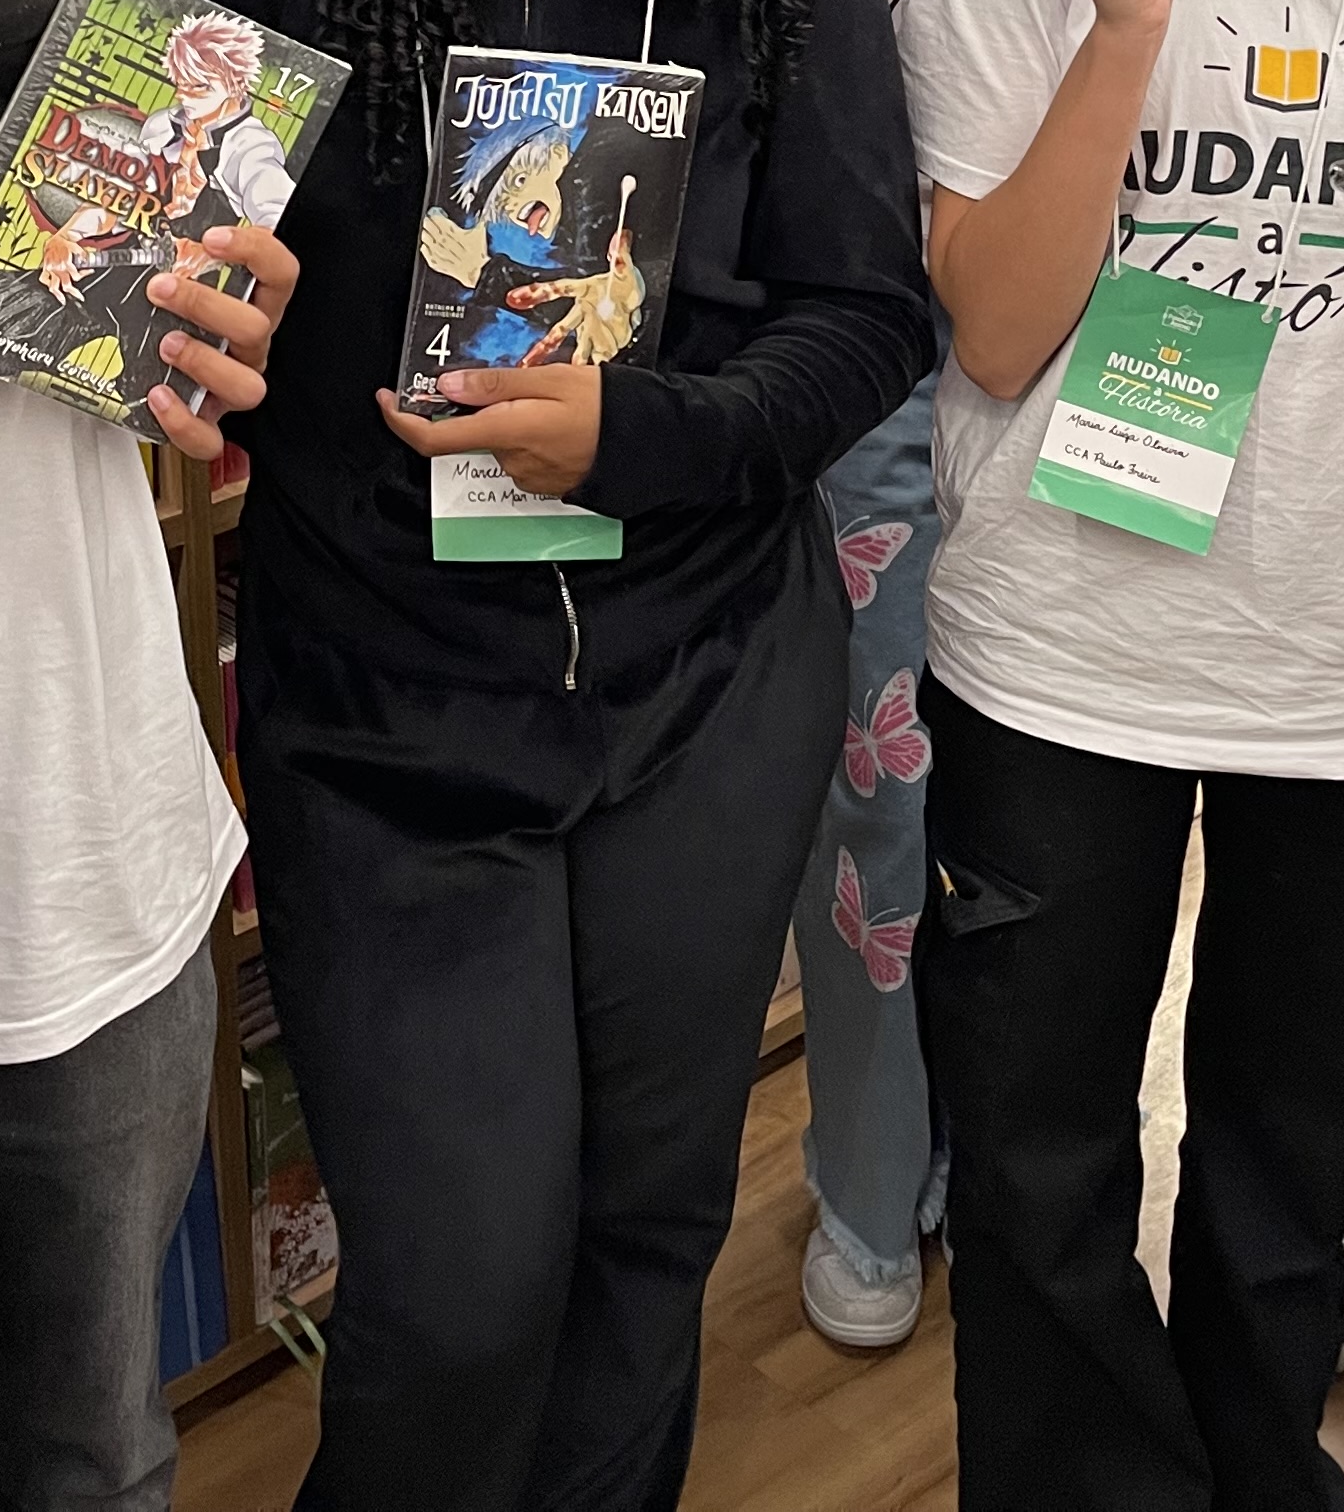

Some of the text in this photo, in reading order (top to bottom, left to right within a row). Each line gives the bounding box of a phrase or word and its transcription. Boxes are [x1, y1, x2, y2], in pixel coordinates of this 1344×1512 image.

[268, 66, 315, 103] 17
[450, 69, 695, 140] JUJUTSU KAISEN
[35, 105, 183, 204] DEMON
[14, 149, 163, 238] SLAYER
[1258, 222, 1283, 255] a
[425, 323, 451, 367] 4
[57, 359, 117, 394] Gotouge
[413, 371, 437, 395] Geg
[1107, 351, 1220, 400] MUDANDO
[1153, 386, 1163, 397] a
[1098, 373, 1209, 430] História
[1066, 413, 1106, 432] Maria
[452, 460, 506, 481] Marcel
[1065, 443, 1089, 460] CCA
[1094, 452, 1125, 470] Paulo
[467, 491, 496, 503] CCA
[500, 490, 528, 507] Mar
